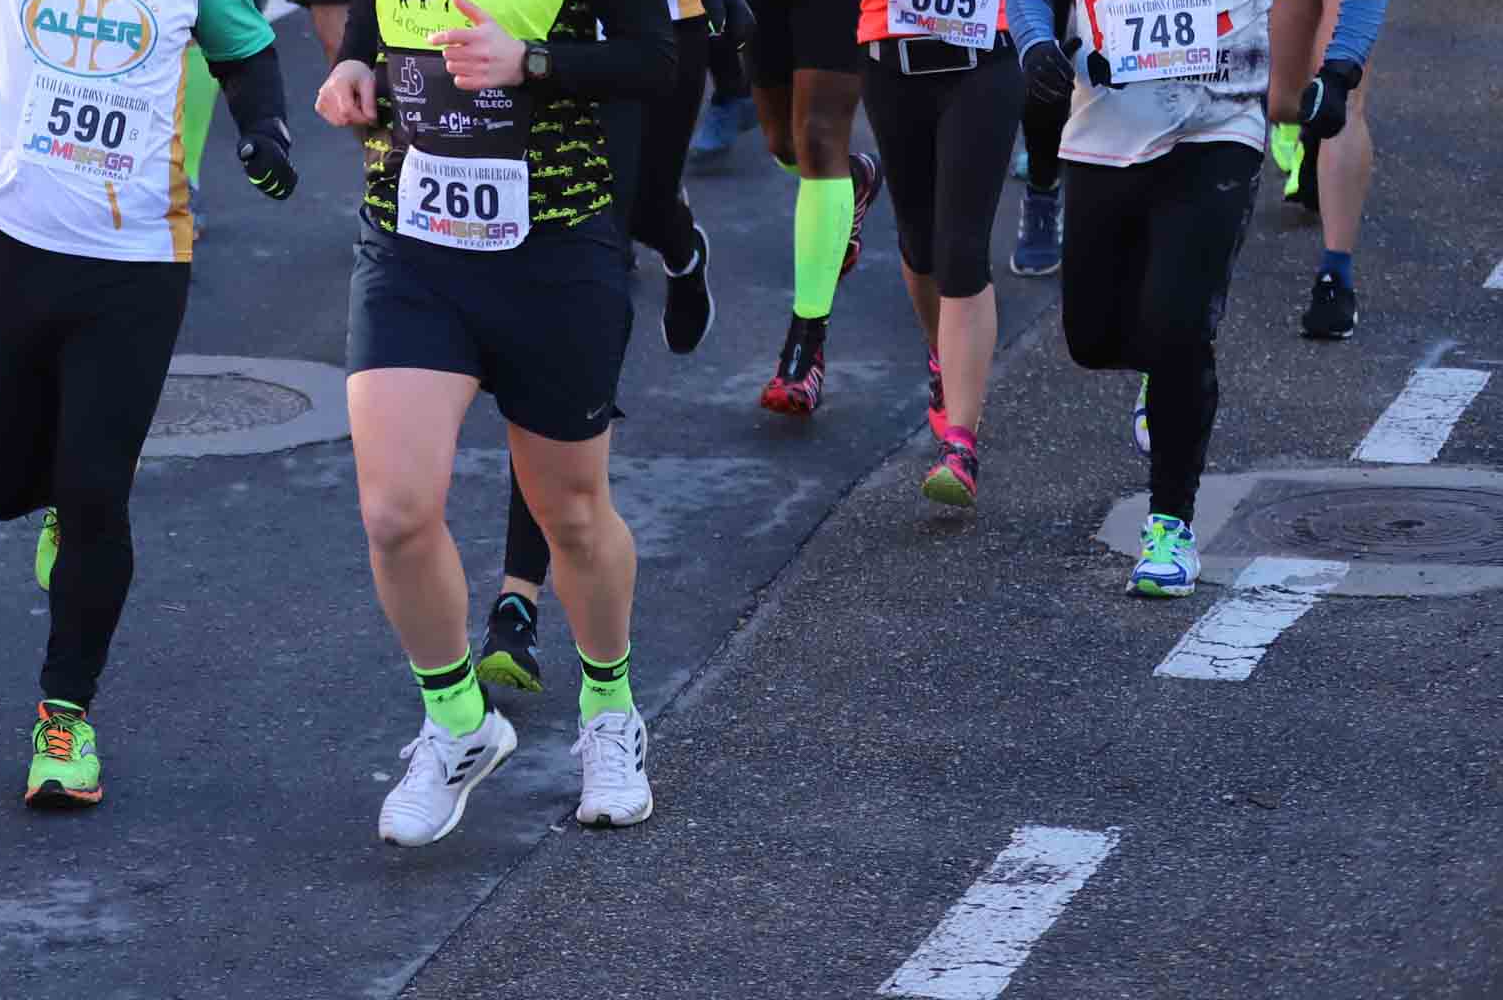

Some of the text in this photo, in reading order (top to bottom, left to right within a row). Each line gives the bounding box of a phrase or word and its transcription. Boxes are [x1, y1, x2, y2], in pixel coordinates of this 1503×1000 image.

[33, 7, 143, 52] ALCER
[1124, 11, 1196, 52] 748
[473, 99, 513, 109] TELECO
[479, 90, 506, 99] AZUL
[47, 97, 127, 149] 590
[418, 177, 499, 220] 260
